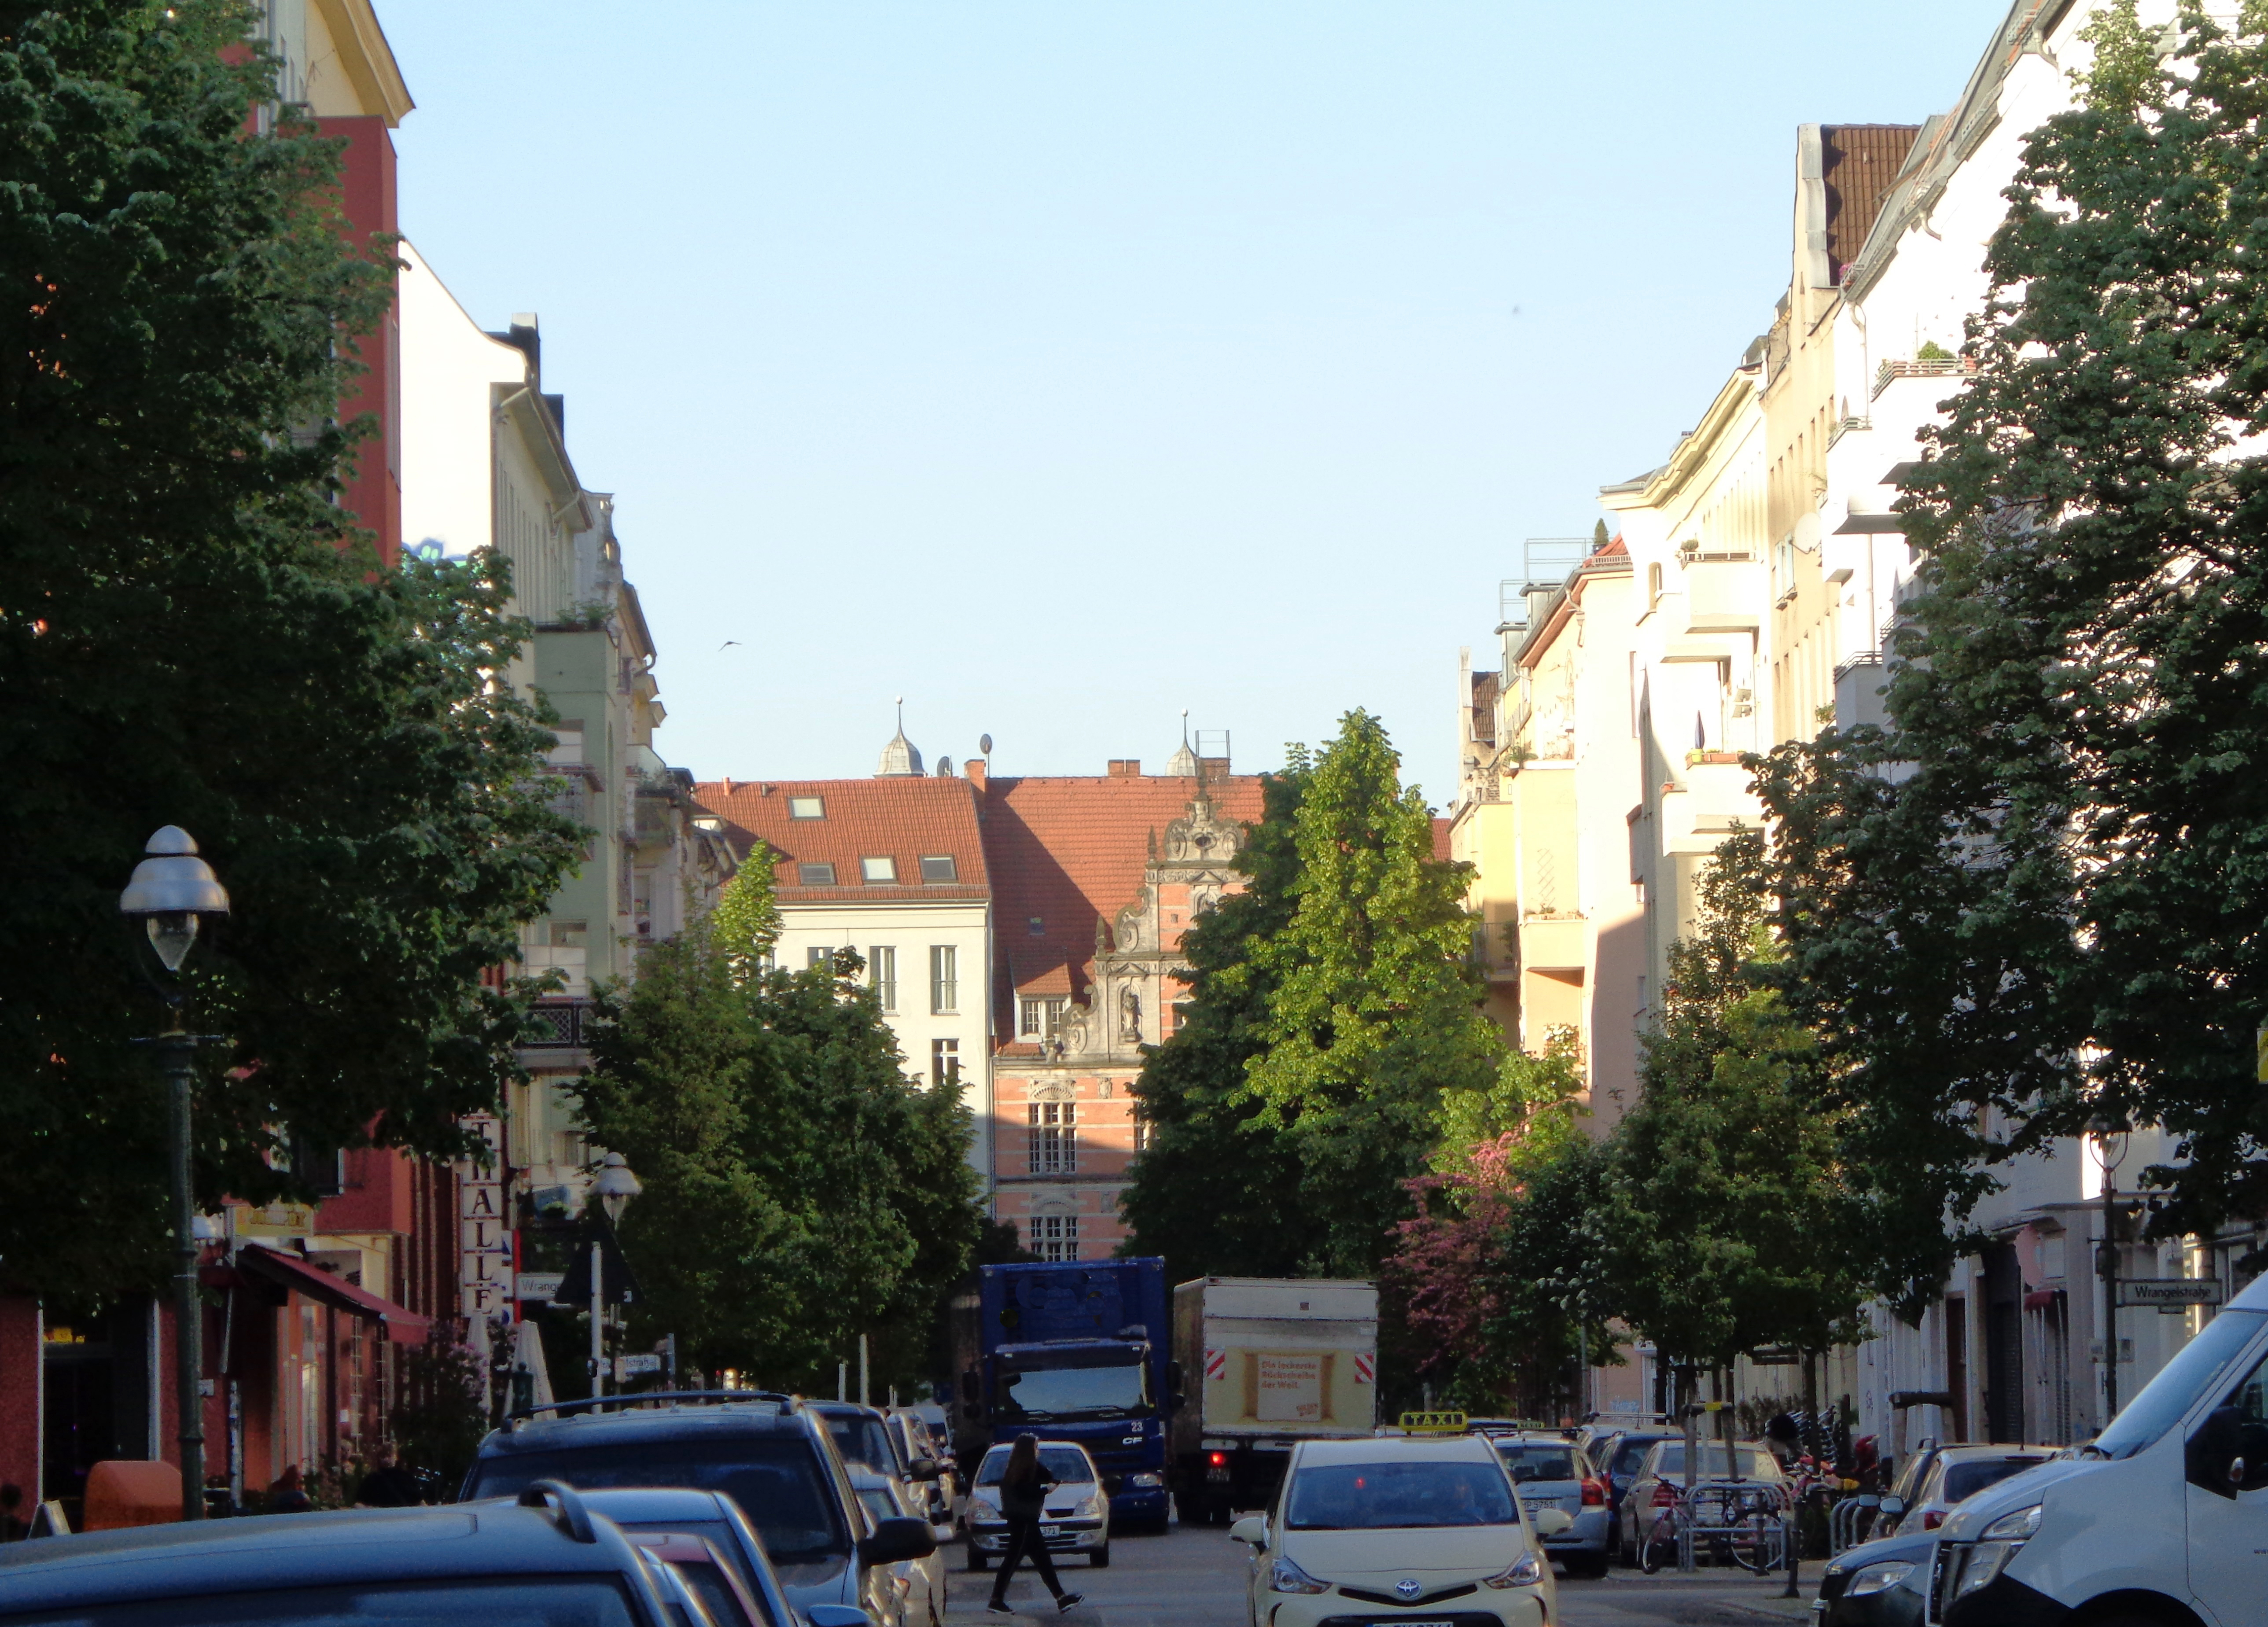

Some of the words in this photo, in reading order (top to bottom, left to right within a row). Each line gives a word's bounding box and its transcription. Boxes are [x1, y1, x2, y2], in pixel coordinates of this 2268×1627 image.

[2135, 1284, 2211, 1301] Wrangelstraße
[1131, 1421, 1143, 1432] 23
[1410, 1414, 1455, 1427] TAXI
